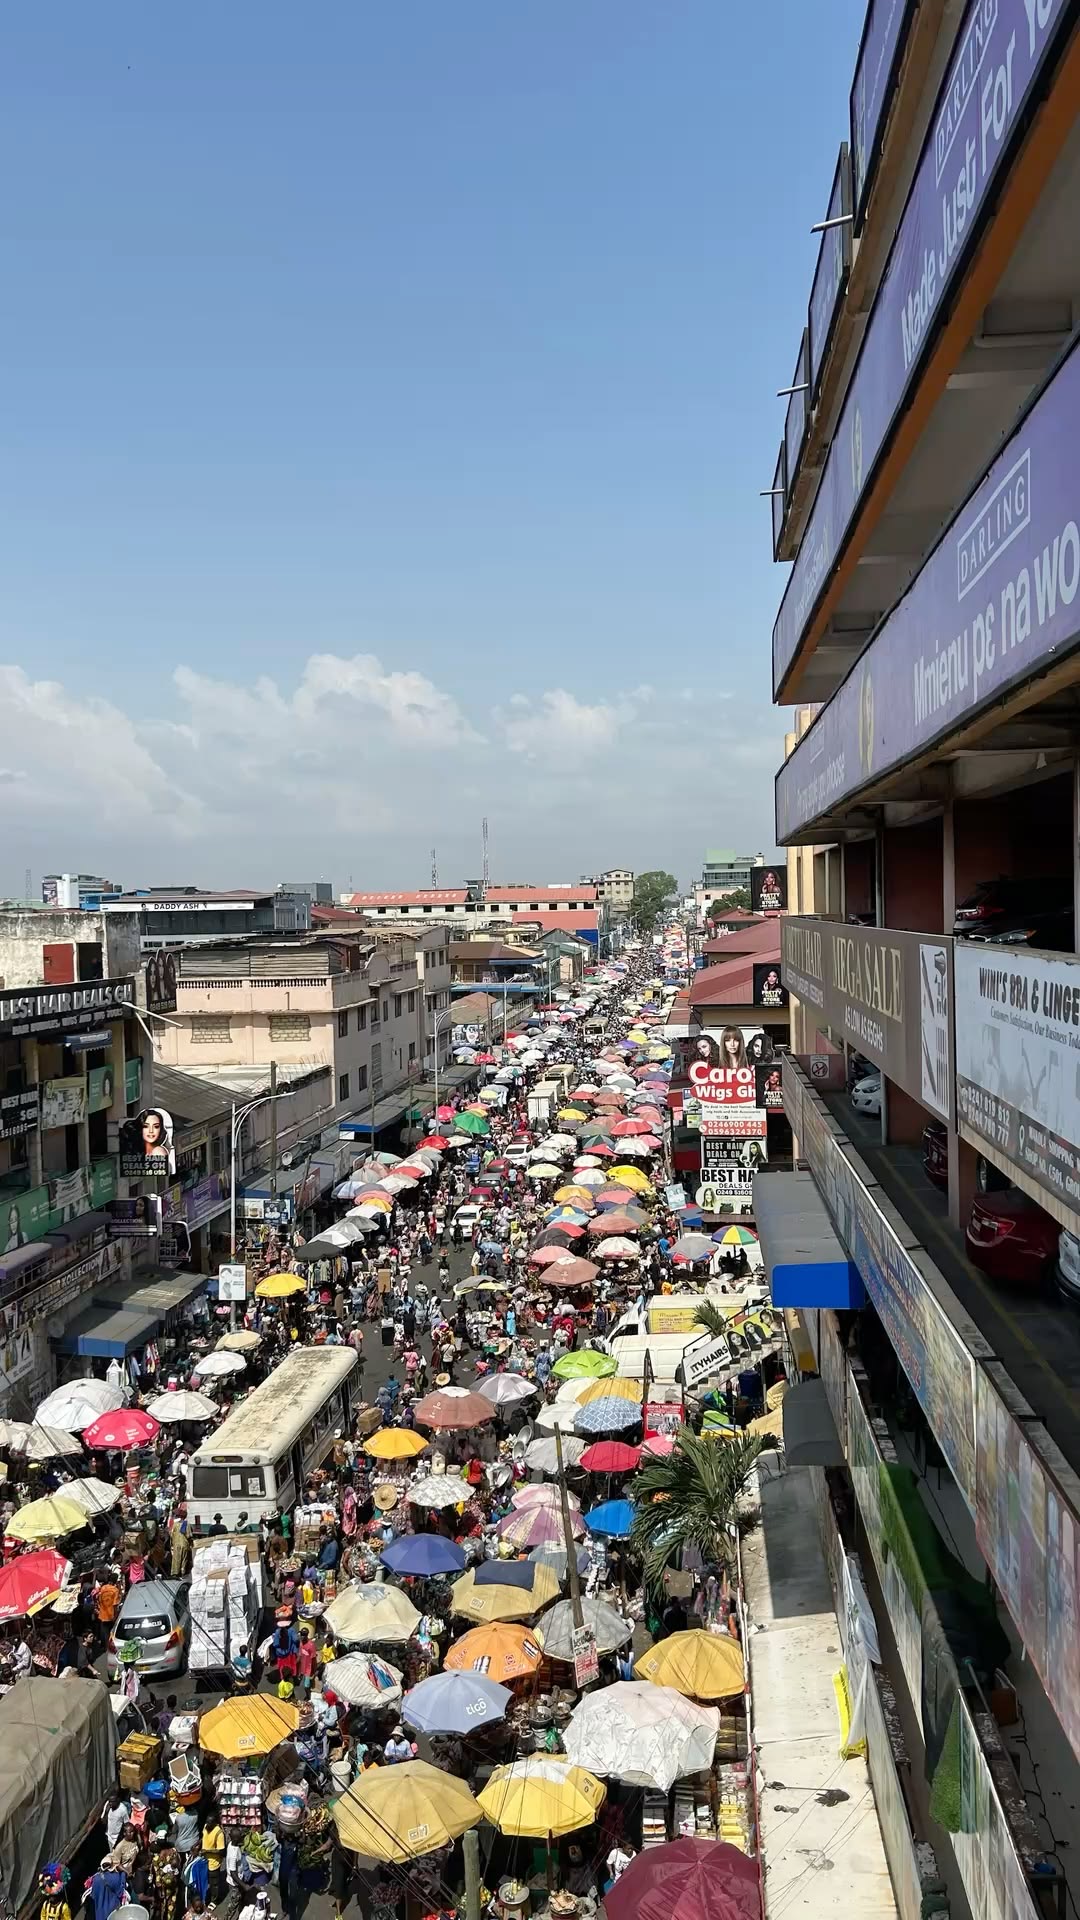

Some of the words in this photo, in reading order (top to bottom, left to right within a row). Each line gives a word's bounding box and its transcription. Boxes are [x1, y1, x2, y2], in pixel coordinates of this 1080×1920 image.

[938, 0, 994, 161] DARLING
[901, 248, 936, 371] Made
[938, 137, 977, 277] Just
[981, 29, 1016, 177] For
[960, 475, 1026, 584] DARLING
[913, 629, 969, 727] Mmienu
[1001, 567, 1031, 656] na
[805, 931, 823, 982] HAIR
[832, 936, 864, 1002] MEGA
[864, 942, 903, 1024] SALE
[979, 967, 1008, 1004] WINI'S
[1009, 973, 1028, 1011] BRA
[1031, 978, 1039, 1014] &
[1, 996, 35, 1021] BEST
[38, 992, 72, 1016] HAIR
[73, 986, 113, 1011] DEALS
[114, 983, 133, 1004] GH
[1034, 1020, 1045, 1036] Our
[1045, 1024, 1067, 1045] Business
[689, 1060, 756, 1085] Caro'
[1, 1094, 19, 1110] BEST
[695, 1085, 733, 1101] Wigs
[736, 1085, 756, 1098] Gh
[706, 1142, 724, 1150] BEST
[726, 1142, 745, 1150] HAIR
[997, 1125, 1009, 1148] 777
[122, 1154, 142, 1162] BEST
[145, 1154, 166, 1162] HAIR
[122, 1162, 150, 1170] DEALS
[151, 1162, 166, 1170] GH
[706, 1150, 728, 1158] DEALS
[701, 1169, 735, 1183] BEST
[465, 1698, 488, 1716] tigo
